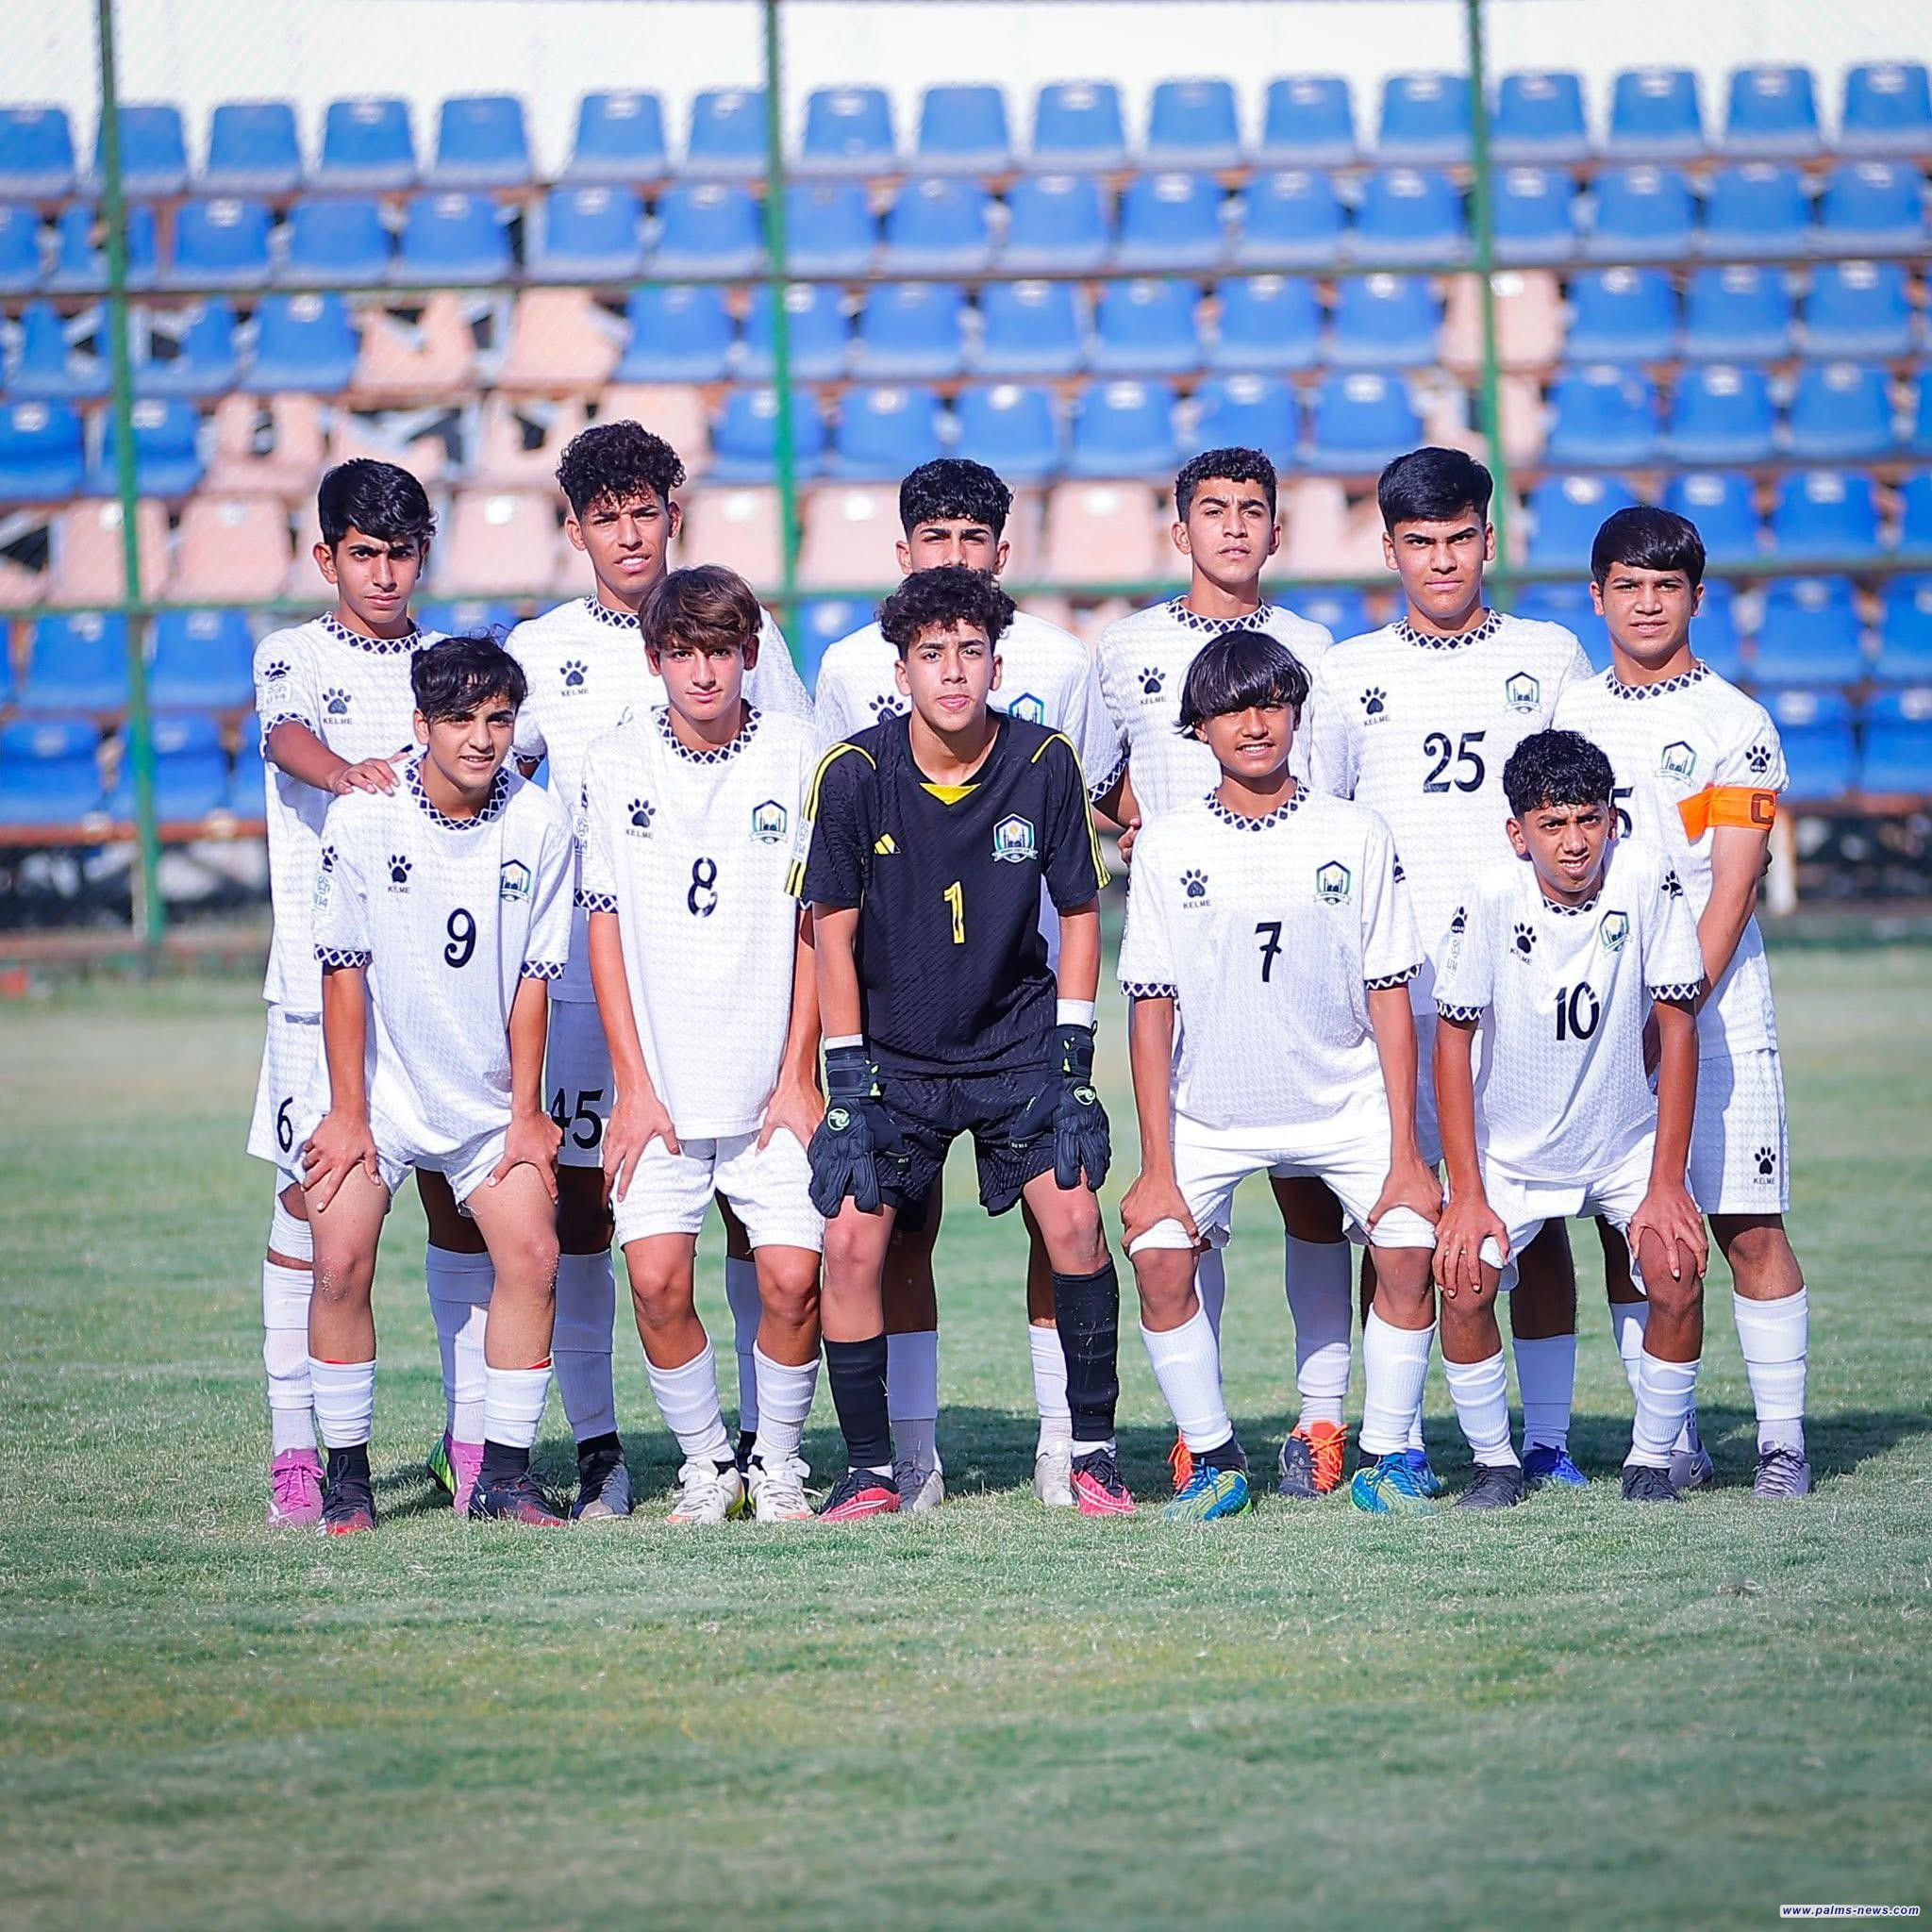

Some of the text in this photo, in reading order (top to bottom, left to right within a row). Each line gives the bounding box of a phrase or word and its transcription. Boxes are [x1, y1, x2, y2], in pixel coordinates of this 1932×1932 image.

[1423, 731, 1486, 792] 25
[625, 828, 654, 839] KELME
[1751, 792, 1774, 824] C
[688, 857, 718, 917] 8
[943, 881, 965, 944] 1
[1183, 899, 1211, 908] KELME
[443, 908, 476, 968] 9
[1255, 921, 1282, 983] 7
[1556, 981, 1600, 1041] 10
[276, 1096, 293, 1154] 6
[550, 1088, 604, 1149] 45
